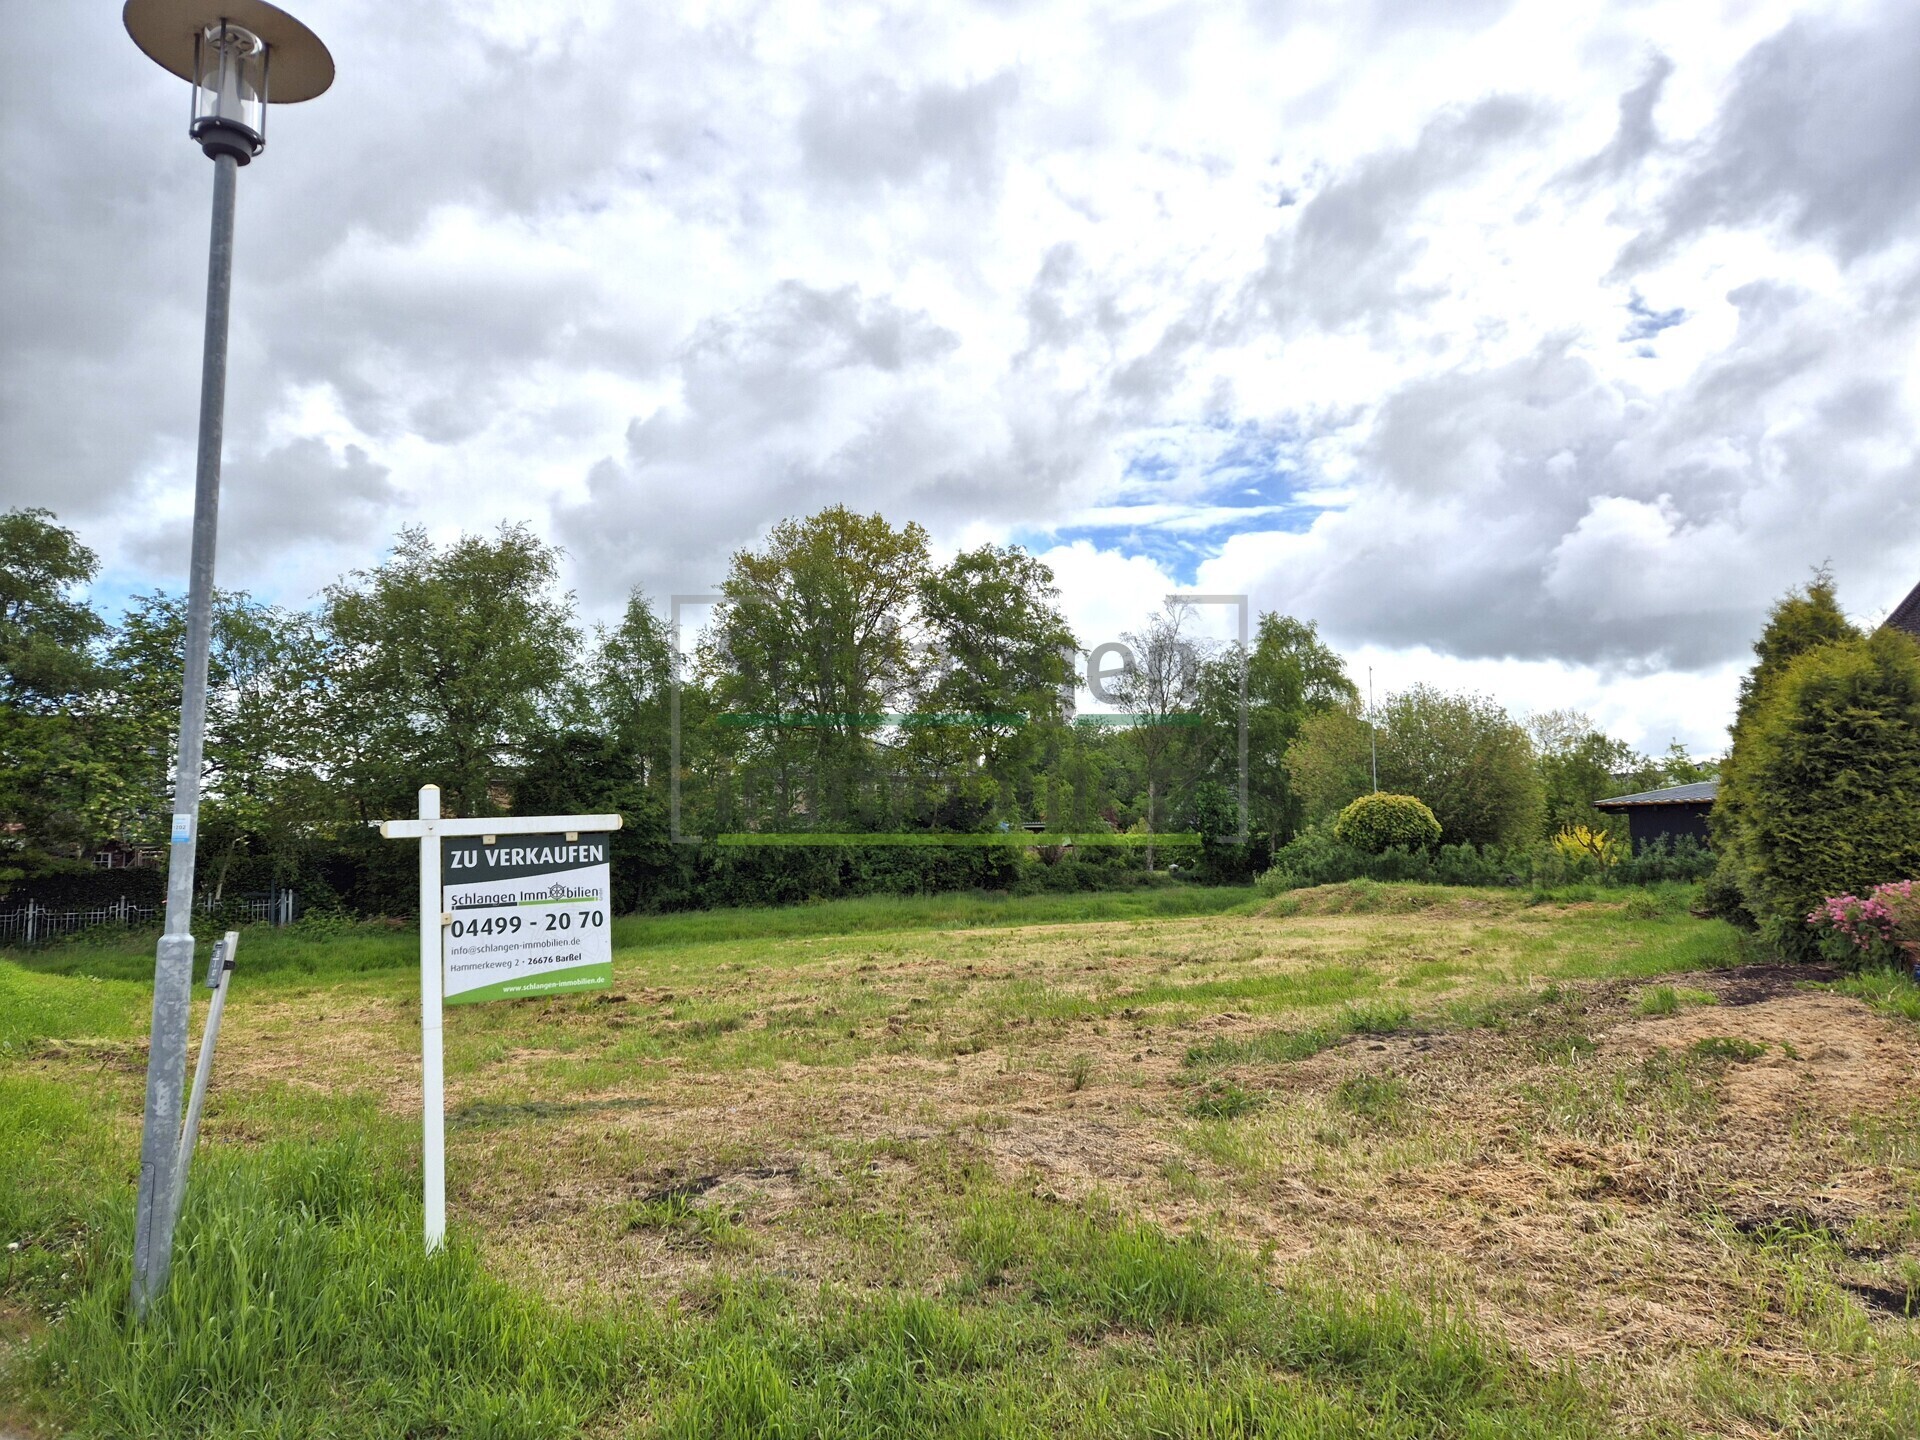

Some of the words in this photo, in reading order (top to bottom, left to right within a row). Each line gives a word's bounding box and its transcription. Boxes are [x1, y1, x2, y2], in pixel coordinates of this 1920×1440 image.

[450, 850, 478, 869] ZU
[485, 844, 603, 867] VERKAUFEN
[451, 892, 516, 906] Schlangen
[451, 915, 522, 938] 04499
[545, 912, 571, 931] 20
[579, 910, 604, 929] 70
[451, 937, 581, 956] info@schlangen-immobilien.de
[450, 960, 512, 972] Hammerkeweg
[514, 959, 520, 967] 2
[527, 956, 554, 966] 26676
[555, 953, 582, 963] Barßel
[502, 976, 605, 993] www.schlangen-immobilien.de
